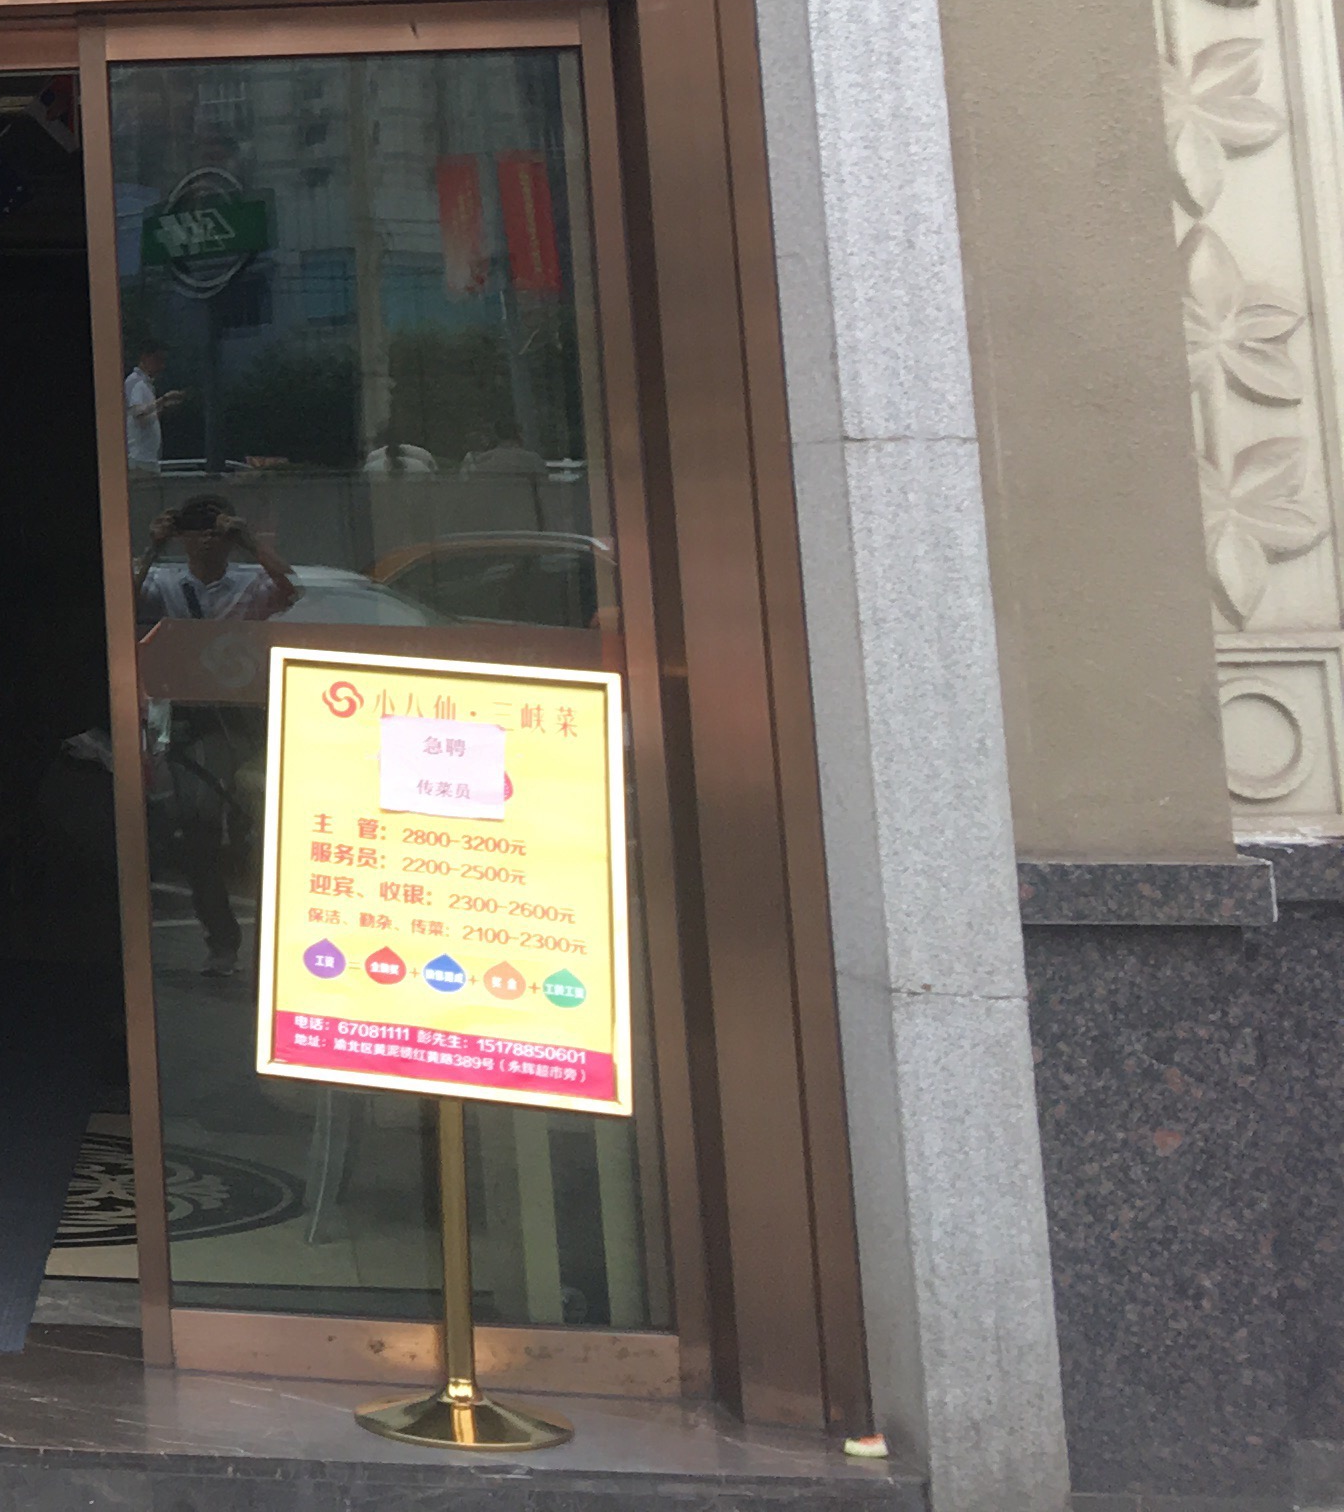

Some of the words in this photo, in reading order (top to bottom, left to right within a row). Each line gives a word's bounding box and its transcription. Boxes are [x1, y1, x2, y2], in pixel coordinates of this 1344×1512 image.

[422, 735, 467, 758] 急聘
[417, 779, 472, 801] 传菜员
